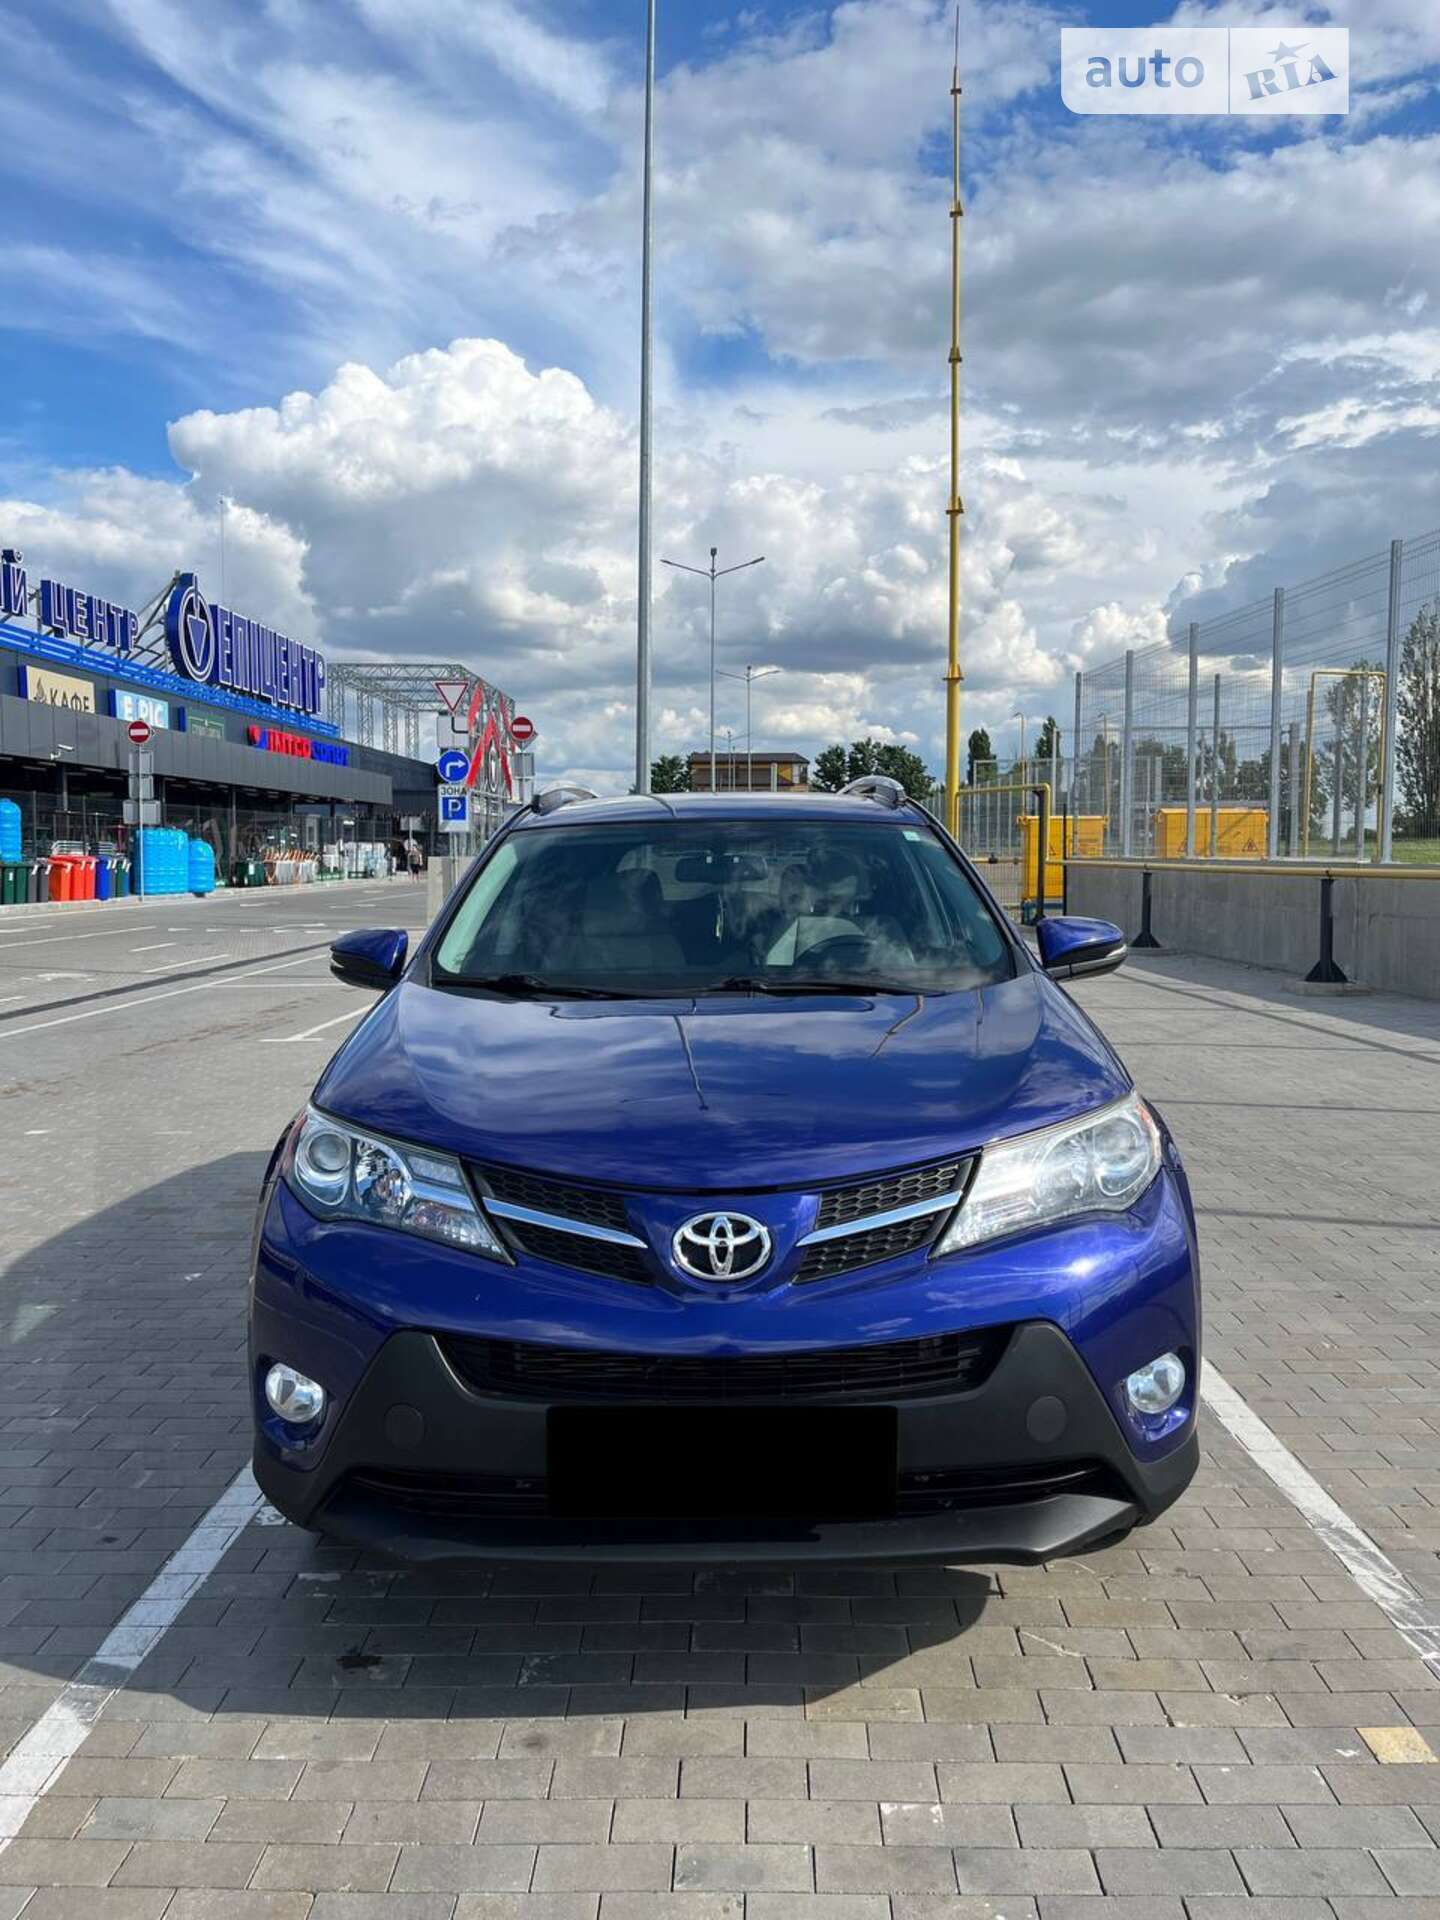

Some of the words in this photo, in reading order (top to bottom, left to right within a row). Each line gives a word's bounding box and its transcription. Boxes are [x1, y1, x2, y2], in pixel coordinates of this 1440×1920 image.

[42, 579, 140, 651] ЦЕНТР
[211, 604, 328, 715] ЕПІЦЕНТР
[49, 687, 89, 712] КАФЕ
[440, 786, 467, 796] ЗОНА
